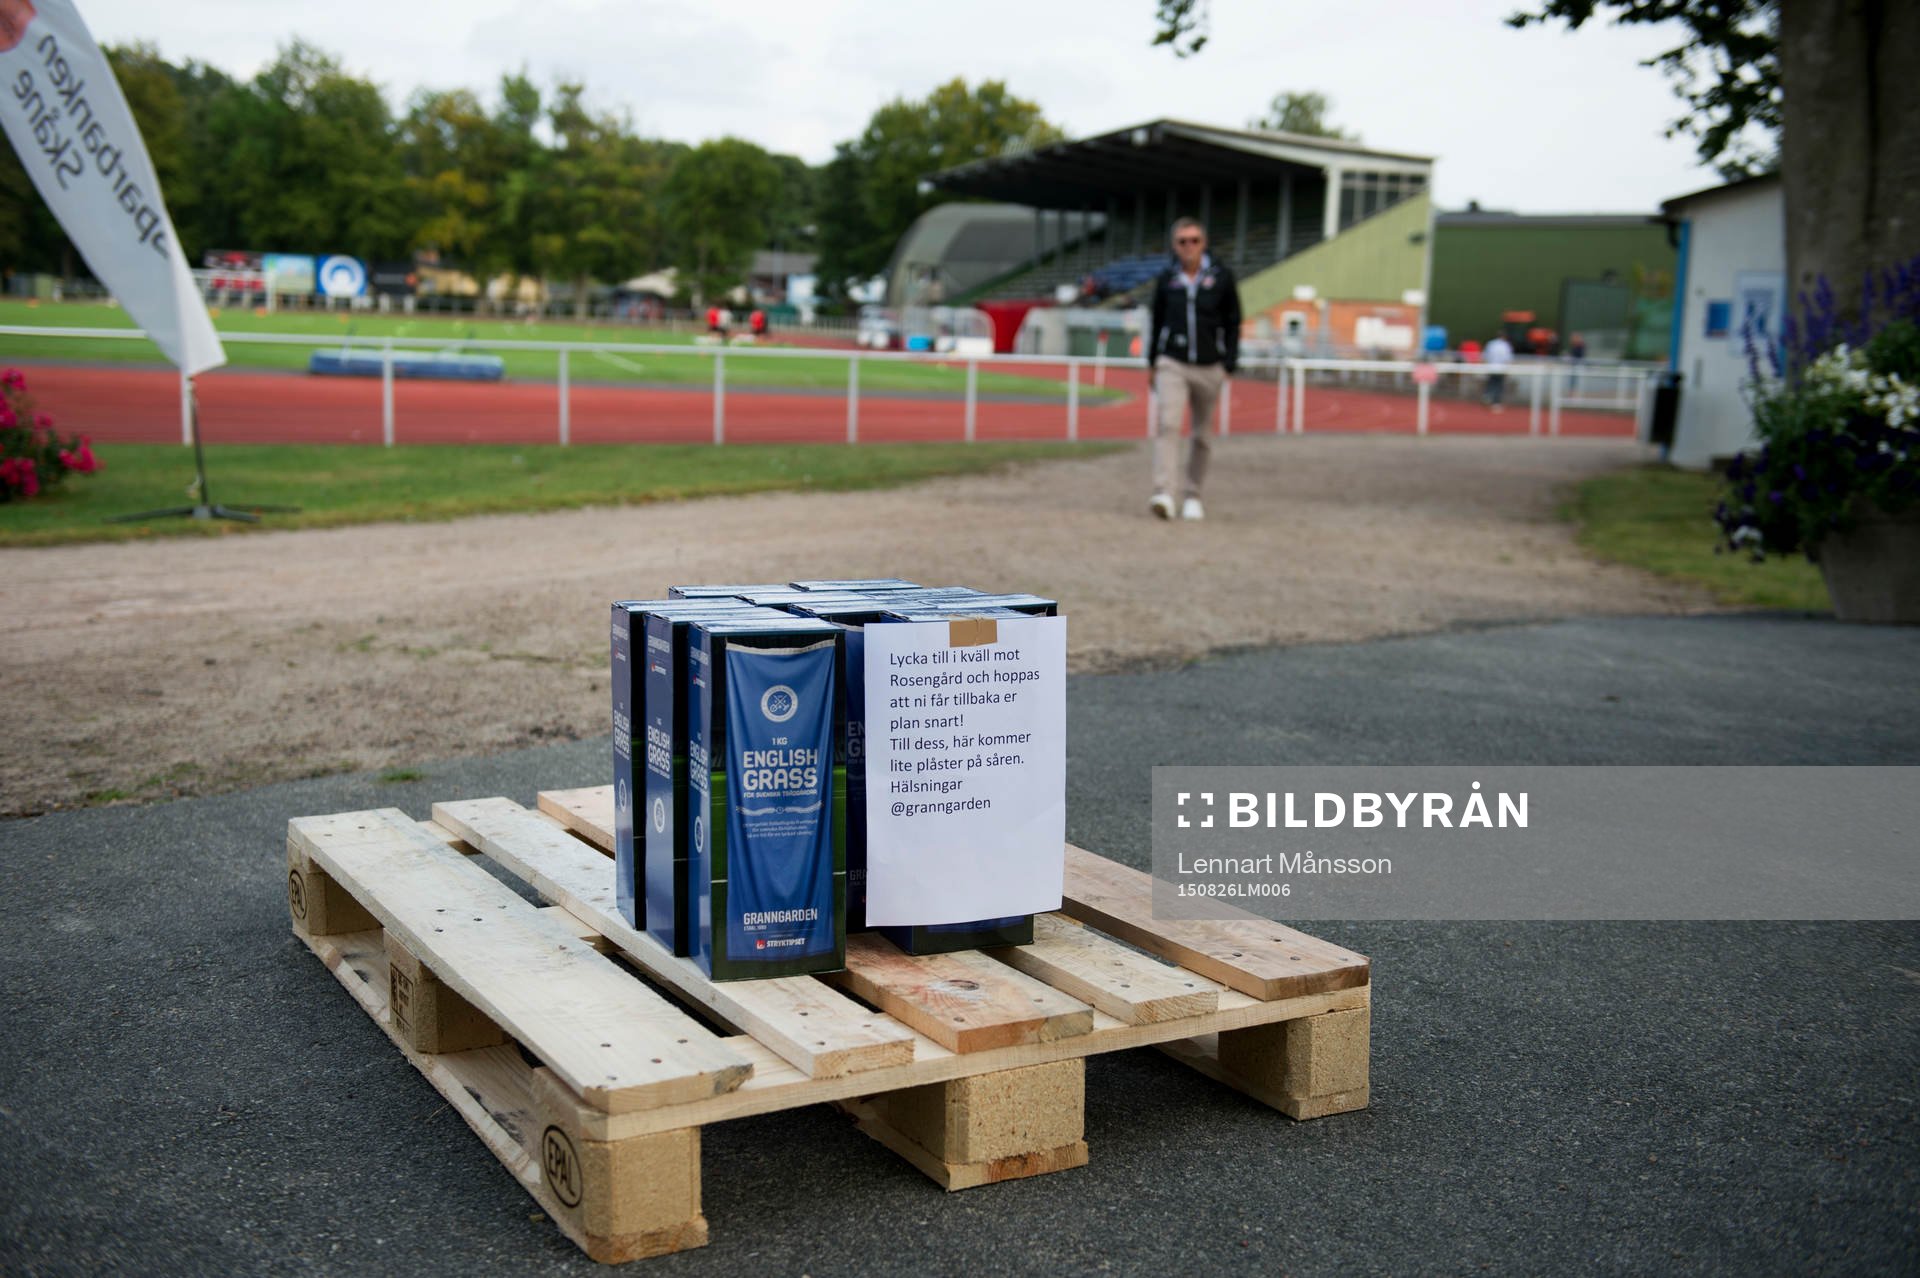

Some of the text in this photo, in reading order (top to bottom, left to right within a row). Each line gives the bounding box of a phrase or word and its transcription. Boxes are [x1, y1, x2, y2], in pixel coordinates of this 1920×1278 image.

[890, 650, 1020, 668] Lycka till i kväll mot
[890, 669, 1040, 688] Rosengård och hoppas
[890, 691, 1017, 708] att ni får tillbaka er
[890, 714, 964, 732] plan snart!
[648, 725, 670, 750] ENGLISH
[890, 733, 1031, 750] Till dess, här kommer
[648, 744, 671, 772] GRASS
[743, 748, 818, 768] ENGLISH
[890, 753, 1024, 774] lite plåster på såren.
[743, 767, 818, 791] GRASS
[891, 779, 963, 794] Hälsningar
[891, 797, 991, 817] @granngarden
